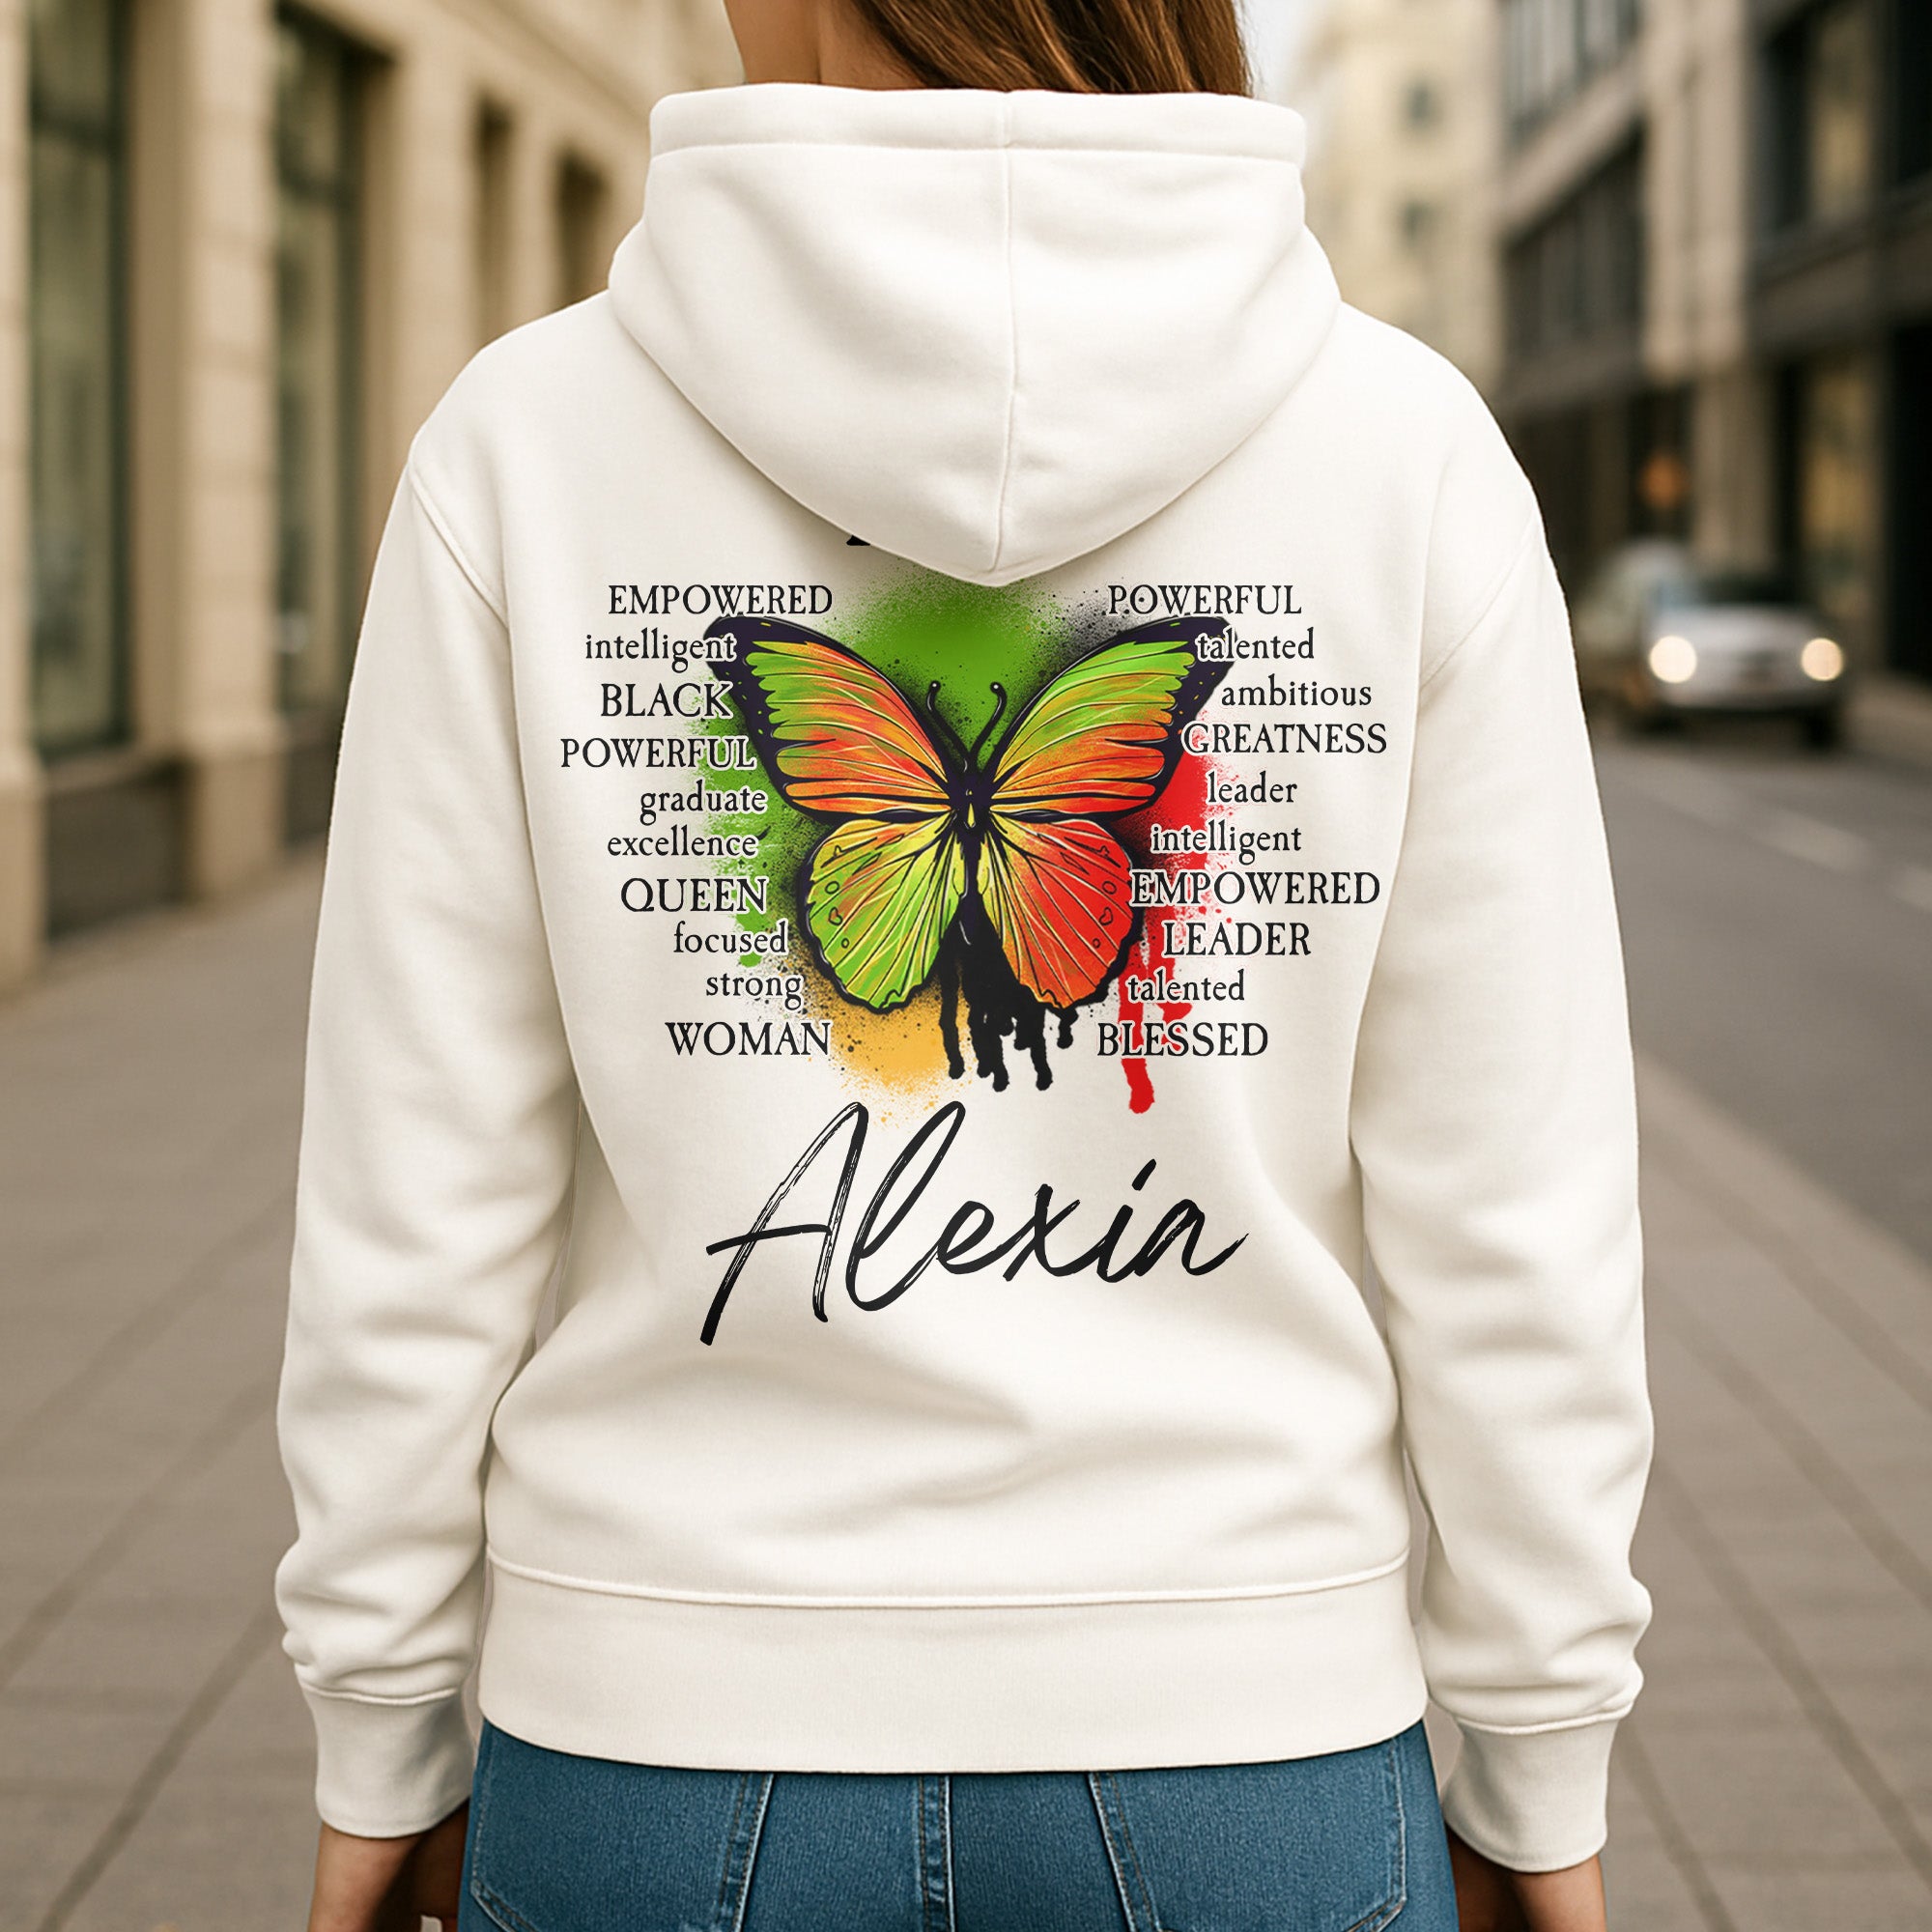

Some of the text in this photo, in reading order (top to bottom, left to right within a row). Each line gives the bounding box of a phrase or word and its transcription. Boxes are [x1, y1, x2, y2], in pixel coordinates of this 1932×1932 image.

[609, 584, 833, 614] EMPOWERED
[1108, 584, 1302, 615] POWERFUL
[585, 629, 737, 673] intelligent
[1197, 628, 1315, 659] talented
[601, 683, 733, 718] BLACK
[1221, 674, 1373, 707] ambitious
[560, 738, 756, 769] POWERFUL
[1182, 723, 1387, 754] GREATNESS
[639, 781, 767, 826] graduate
[1208, 771, 1297, 804] leader
[607, 826, 757, 856] excellence
[1151, 820, 1302, 865] intelligent
[620, 878, 768, 913] QUEEN
[1131, 871, 1380, 905] EMPOWERED
[673, 922, 787, 953] focused
[1163, 923, 1312, 956] LEADER
[706, 973, 804, 1010] strong
[1128, 969, 1245, 1002] talented
[666, 1021, 832, 1057] WOMAN
[1097, 1022, 1268, 1057] BLESSED
[699, 1100, 1249, 1347] Alexia
